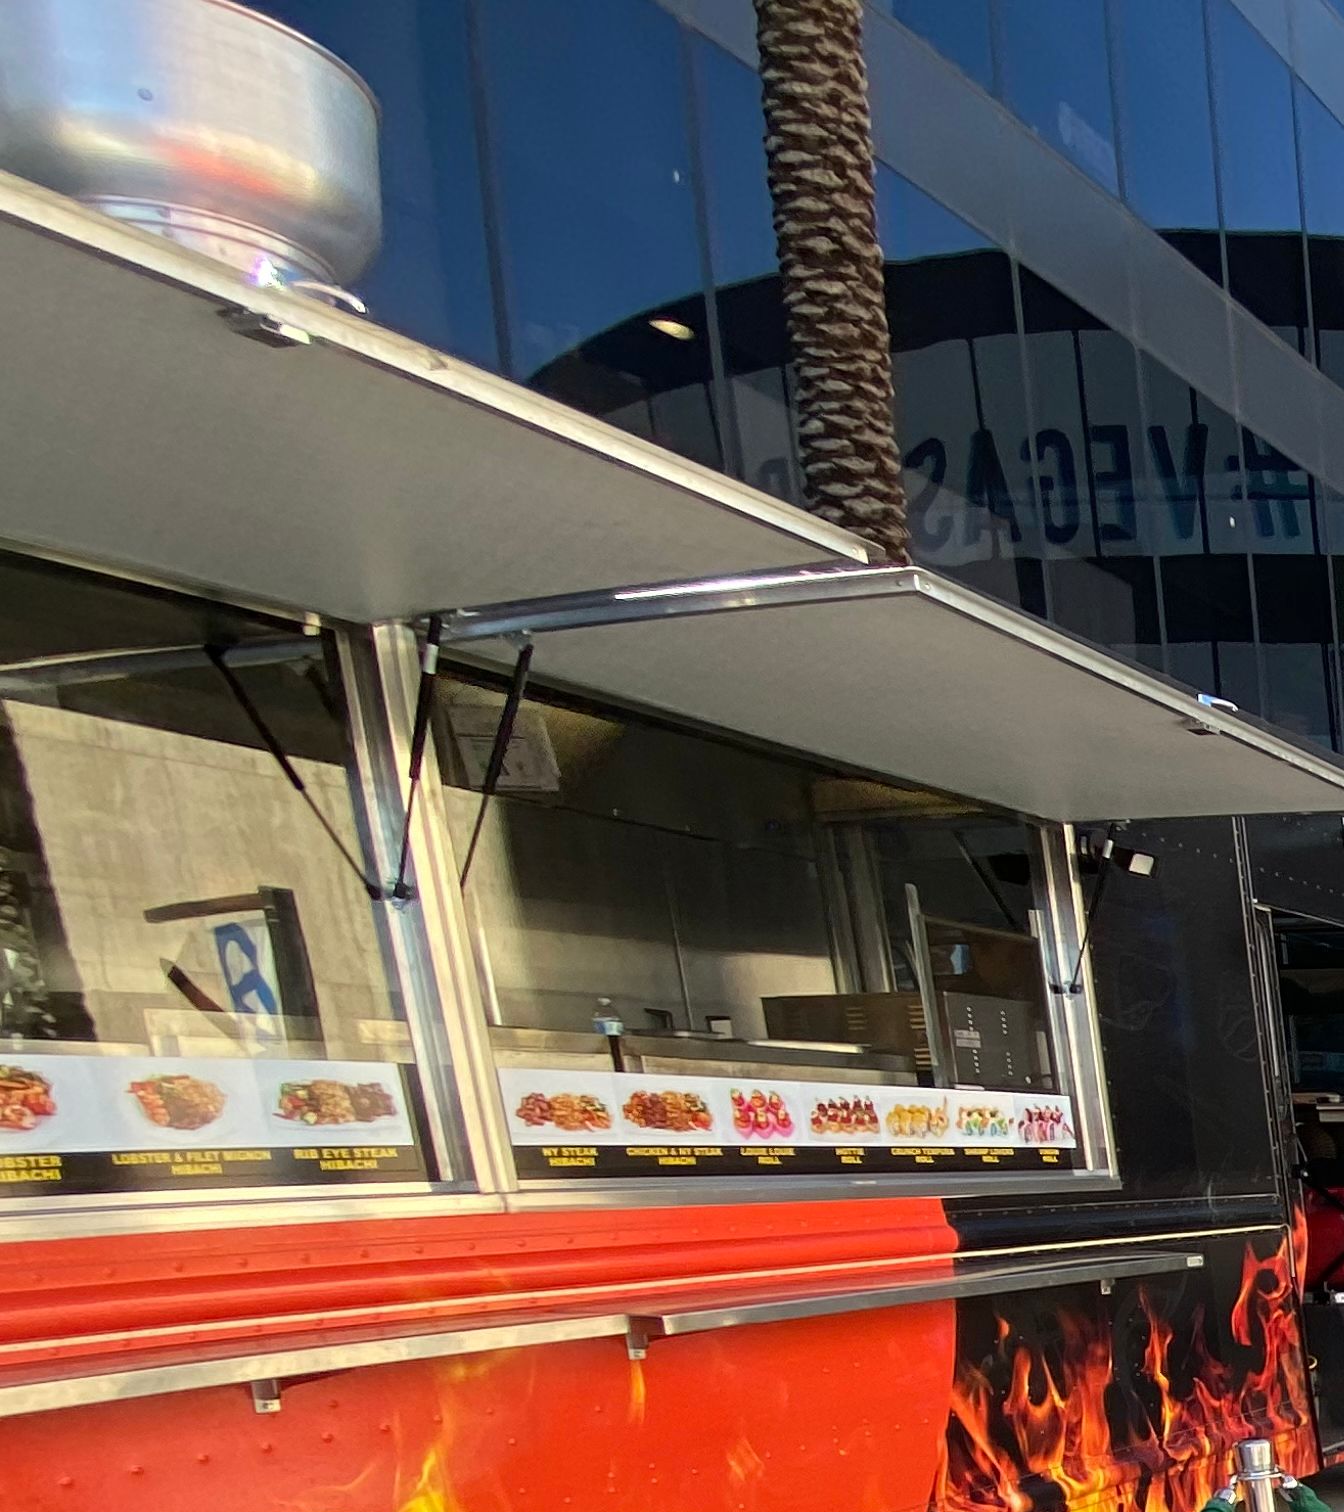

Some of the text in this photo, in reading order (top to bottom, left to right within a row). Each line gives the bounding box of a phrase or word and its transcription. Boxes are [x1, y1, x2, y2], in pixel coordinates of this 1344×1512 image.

[321, 1149, 350, 1159] EYE
[352, 1148, 398, 1158] STEAK
[542, 1147, 599, 1157] NY STEAK
